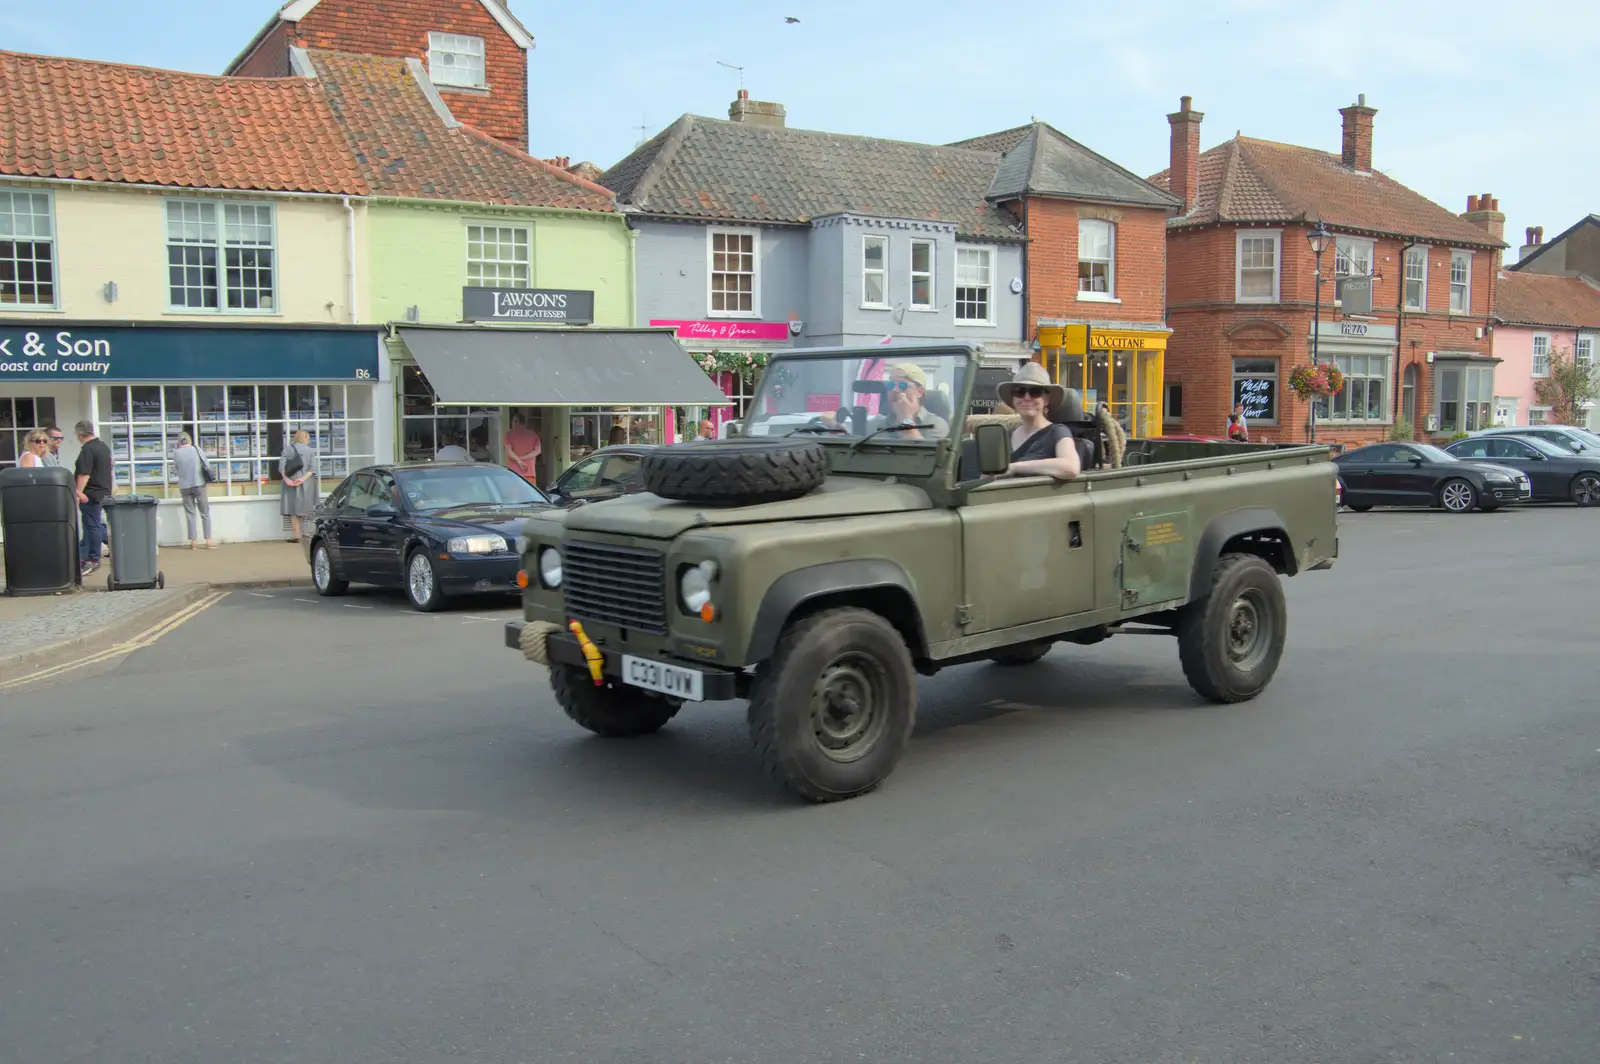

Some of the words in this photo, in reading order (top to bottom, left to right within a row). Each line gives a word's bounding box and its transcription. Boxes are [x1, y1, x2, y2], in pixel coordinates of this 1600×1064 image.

[492, 292, 567, 317] LAWSON'S
[510, 309, 567, 318] DELICATESSEN
[688, 322, 718, 337] Tilley
[727, 323, 757, 338] Grace
[22, 331, 47, 357] &
[56, 331, 110, 357] Son
[0, 361, 29, 372] oast
[33, 359, 58, 372] and
[62, 361, 110, 375] country
[356, 368, 370, 379] 136
[1240, 379, 1270, 392] Pasta
[1240, 391, 1269, 404] Pizza
[631, 661, 661, 687] C331
